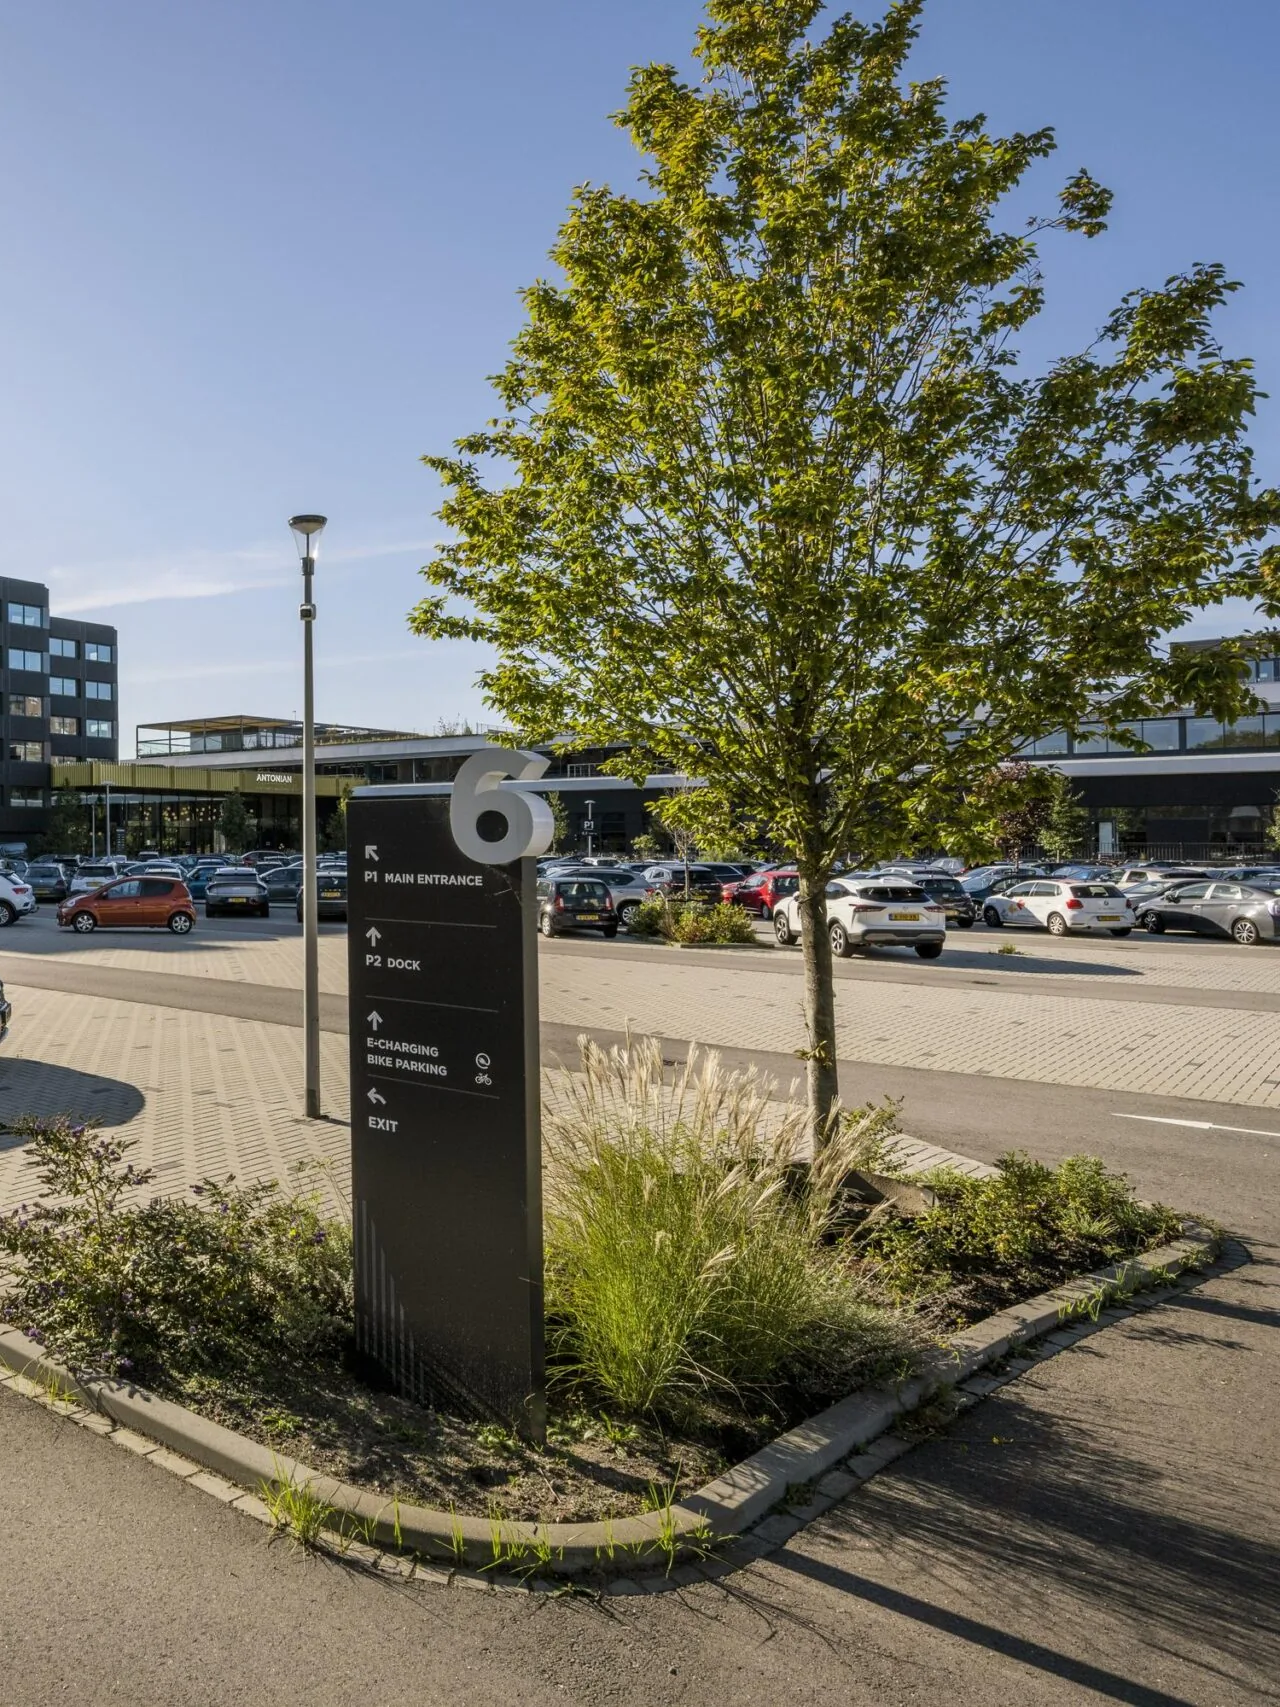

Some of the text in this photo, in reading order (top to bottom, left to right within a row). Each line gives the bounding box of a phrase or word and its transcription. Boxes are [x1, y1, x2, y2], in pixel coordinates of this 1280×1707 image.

[256, 773, 292, 784] ANTONIAN
[450, 748, 554, 865] 6
[584, 821, 594, 829] P1
[364, 870, 483, 886] P1 MAIN ENTRANCE
[365, 954, 421, 971] P2 DOCK
[366, 1037, 439, 1058] E-CHARGING
[367, 1053, 448, 1076] BIKE PARKING
[368, 1116, 399, 1133] EXIT
